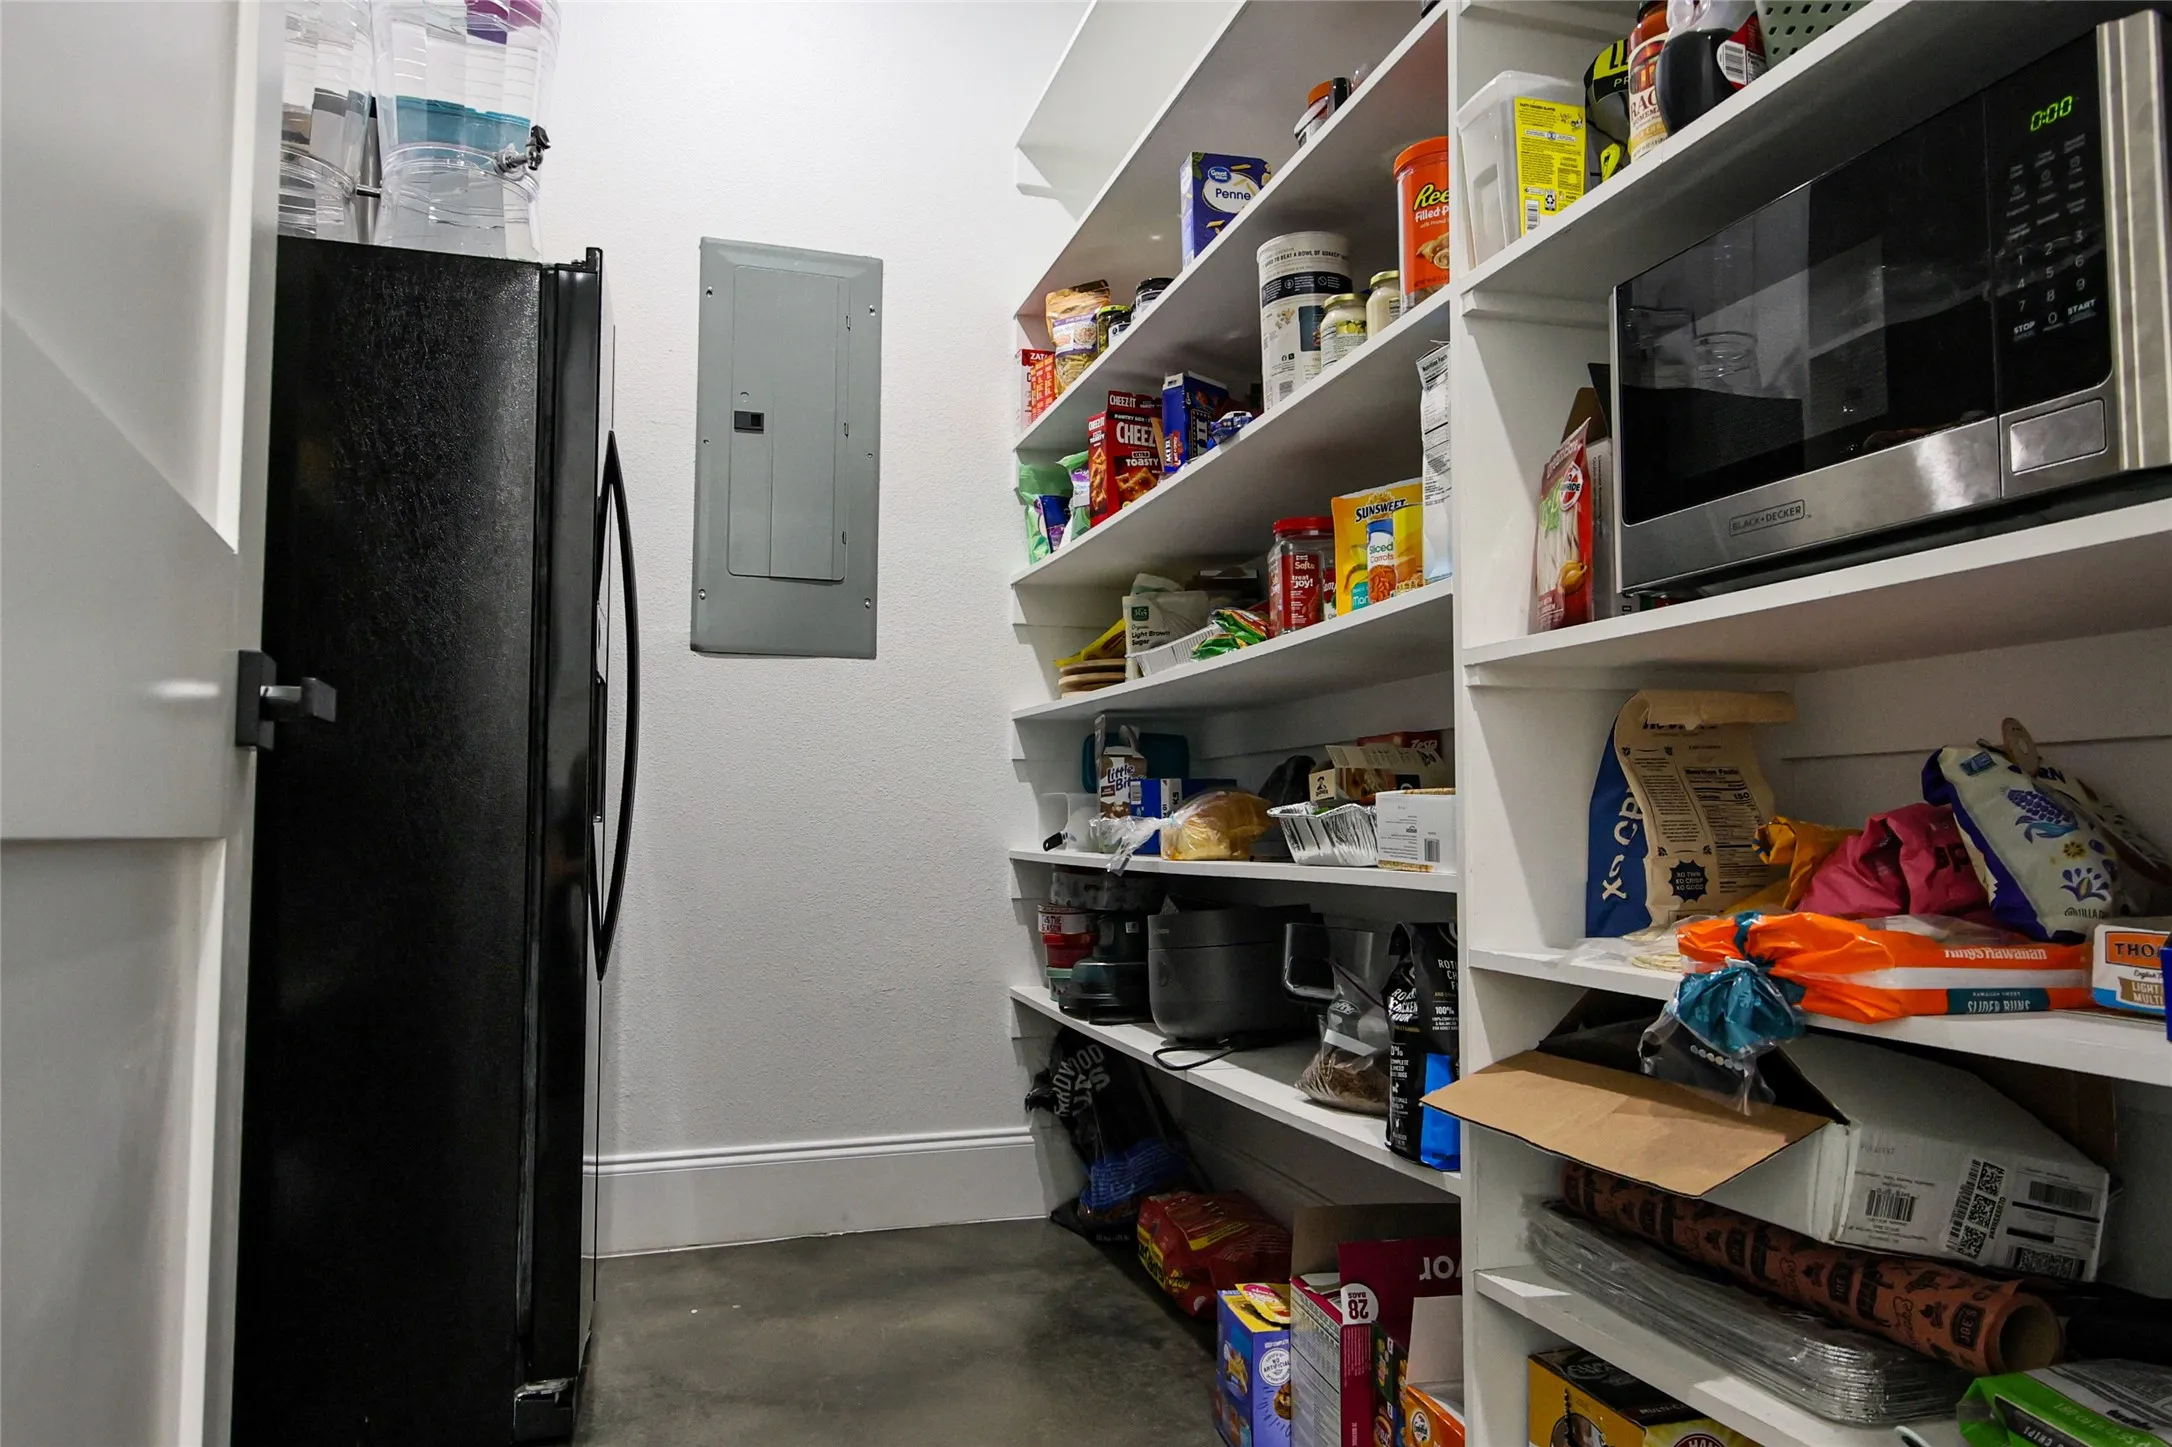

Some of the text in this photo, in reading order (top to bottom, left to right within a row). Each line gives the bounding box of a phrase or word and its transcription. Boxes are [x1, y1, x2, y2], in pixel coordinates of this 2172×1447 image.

[2030, 95, 2073, 132] 0:00
[1215, 188, 1251, 201] Penne
[1415, 208, 1440, 222] Filled
[2044, 242, 2053, 256] 2
[2017, 254, 2084, 289] 4 5 6
[2046, 289, 2055, 302] 8
[2076, 278, 2085, 291] 9
[2013, 320, 2035, 334] STOP
[2067, 298, 2096, 316] START
[1355, 499, 1406, 522] SUNSWEET
[1369, 541, 1394, 555] Sliced
[1370, 553, 1394, 564] Carrots
[1132, 631, 1148, 639] Light
[1107, 765, 1134, 784] Little
[1116, 777, 1141, 791] Bit
[1733, 792, 1750, 800] 150
[2115, 942, 2160, 959] THO
[1347, 1291, 1367, 1299] BAGS
[1348, 1298, 1370, 1321] 28
[1958, 1308, 1976, 1344] JOE'S
